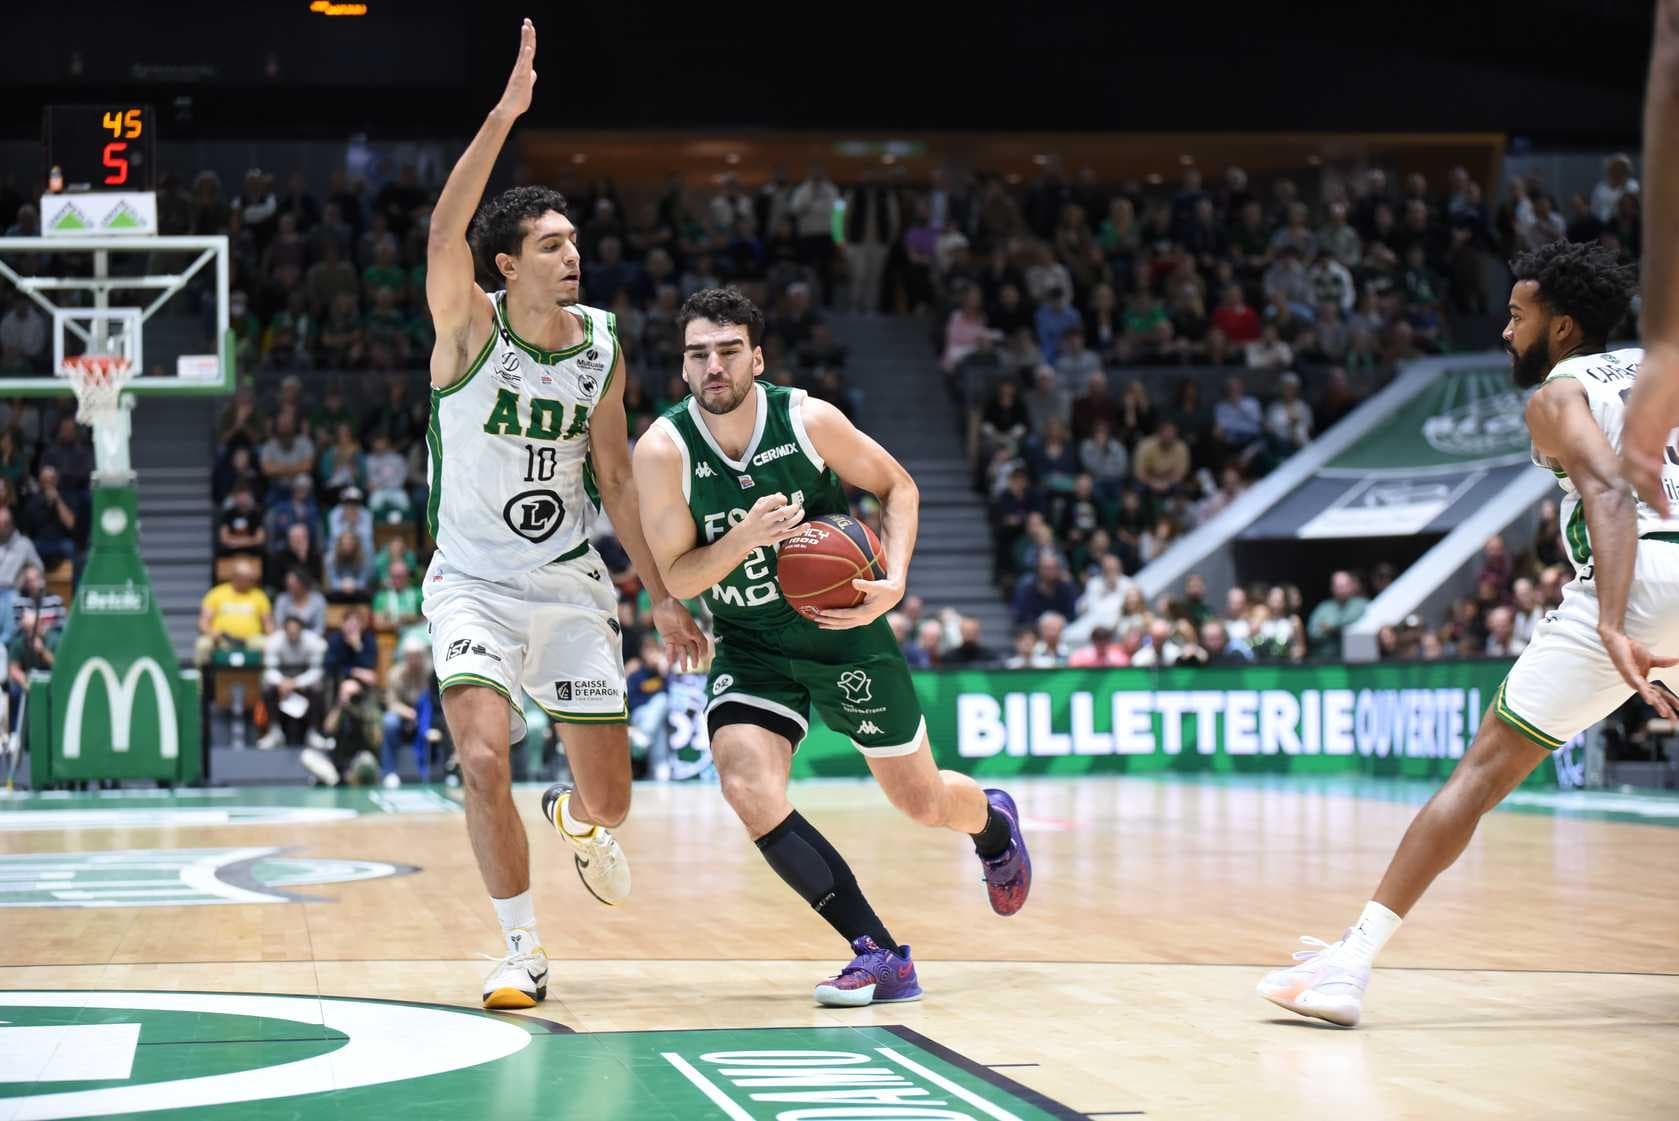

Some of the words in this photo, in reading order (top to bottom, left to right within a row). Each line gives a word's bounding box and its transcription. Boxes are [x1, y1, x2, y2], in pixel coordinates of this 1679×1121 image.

[102, 109, 142, 138] 45
[102, 142, 128, 185] 5
[524, 444, 557, 482] 10
[753, 443, 799, 466] CERMIX
[575, 680, 607, 688] CAISSE
[957, 690, 1355, 757] BILLETTERIE
